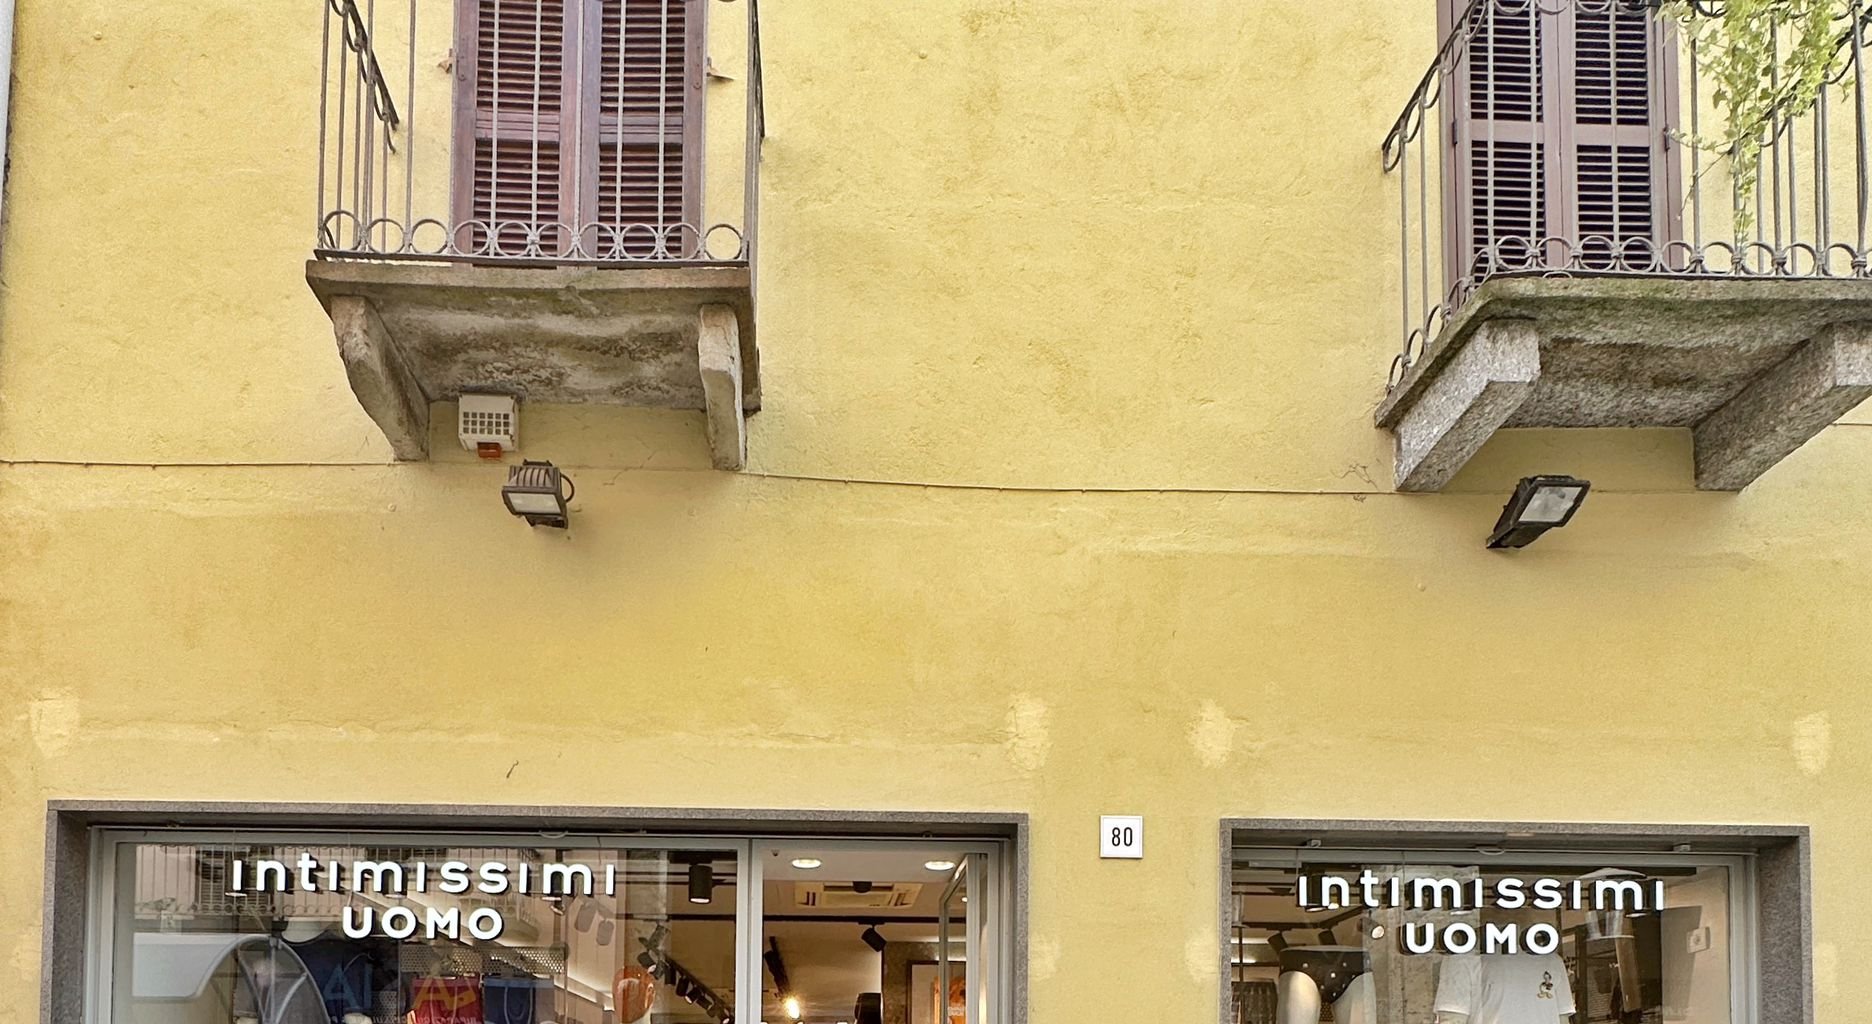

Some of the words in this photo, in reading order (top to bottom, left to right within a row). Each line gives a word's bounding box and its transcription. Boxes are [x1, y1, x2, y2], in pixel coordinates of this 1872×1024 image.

[1111, 826, 1133, 847] 80
[232, 852, 615, 896] intimissimi
[1298, 869, 1665, 911] intimissimi
[341, 906, 503, 940] UOMO
[1405, 922, 1560, 955] UOMO
